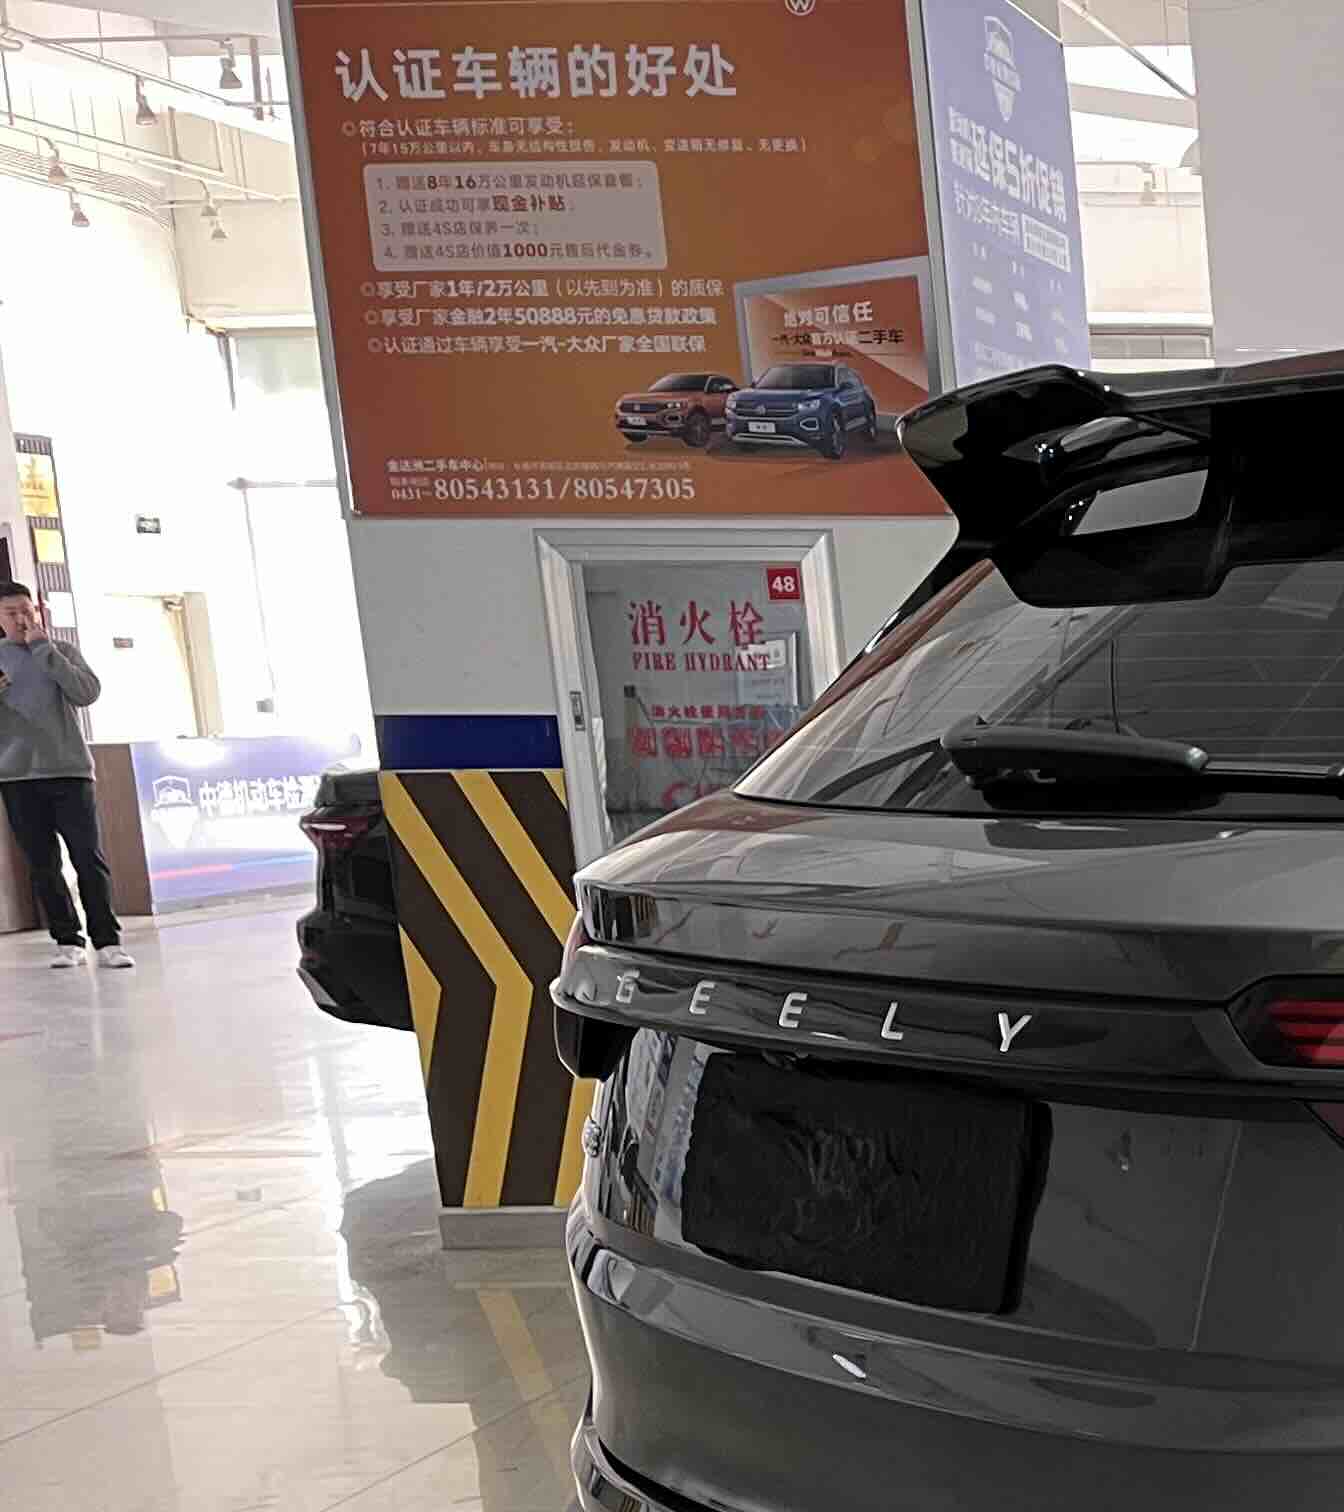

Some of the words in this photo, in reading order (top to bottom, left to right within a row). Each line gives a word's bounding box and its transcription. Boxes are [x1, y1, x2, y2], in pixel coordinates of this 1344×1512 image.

[334, 43, 738, 102] 认证车辆的好处
[771, 575, 796, 593] 48
[628, 600, 768, 650] 消火栓
[631, 651, 677, 672] FIRE
[684, 651, 770, 672] HYDRANT
[615, 968, 1032, 1053] GEELY
